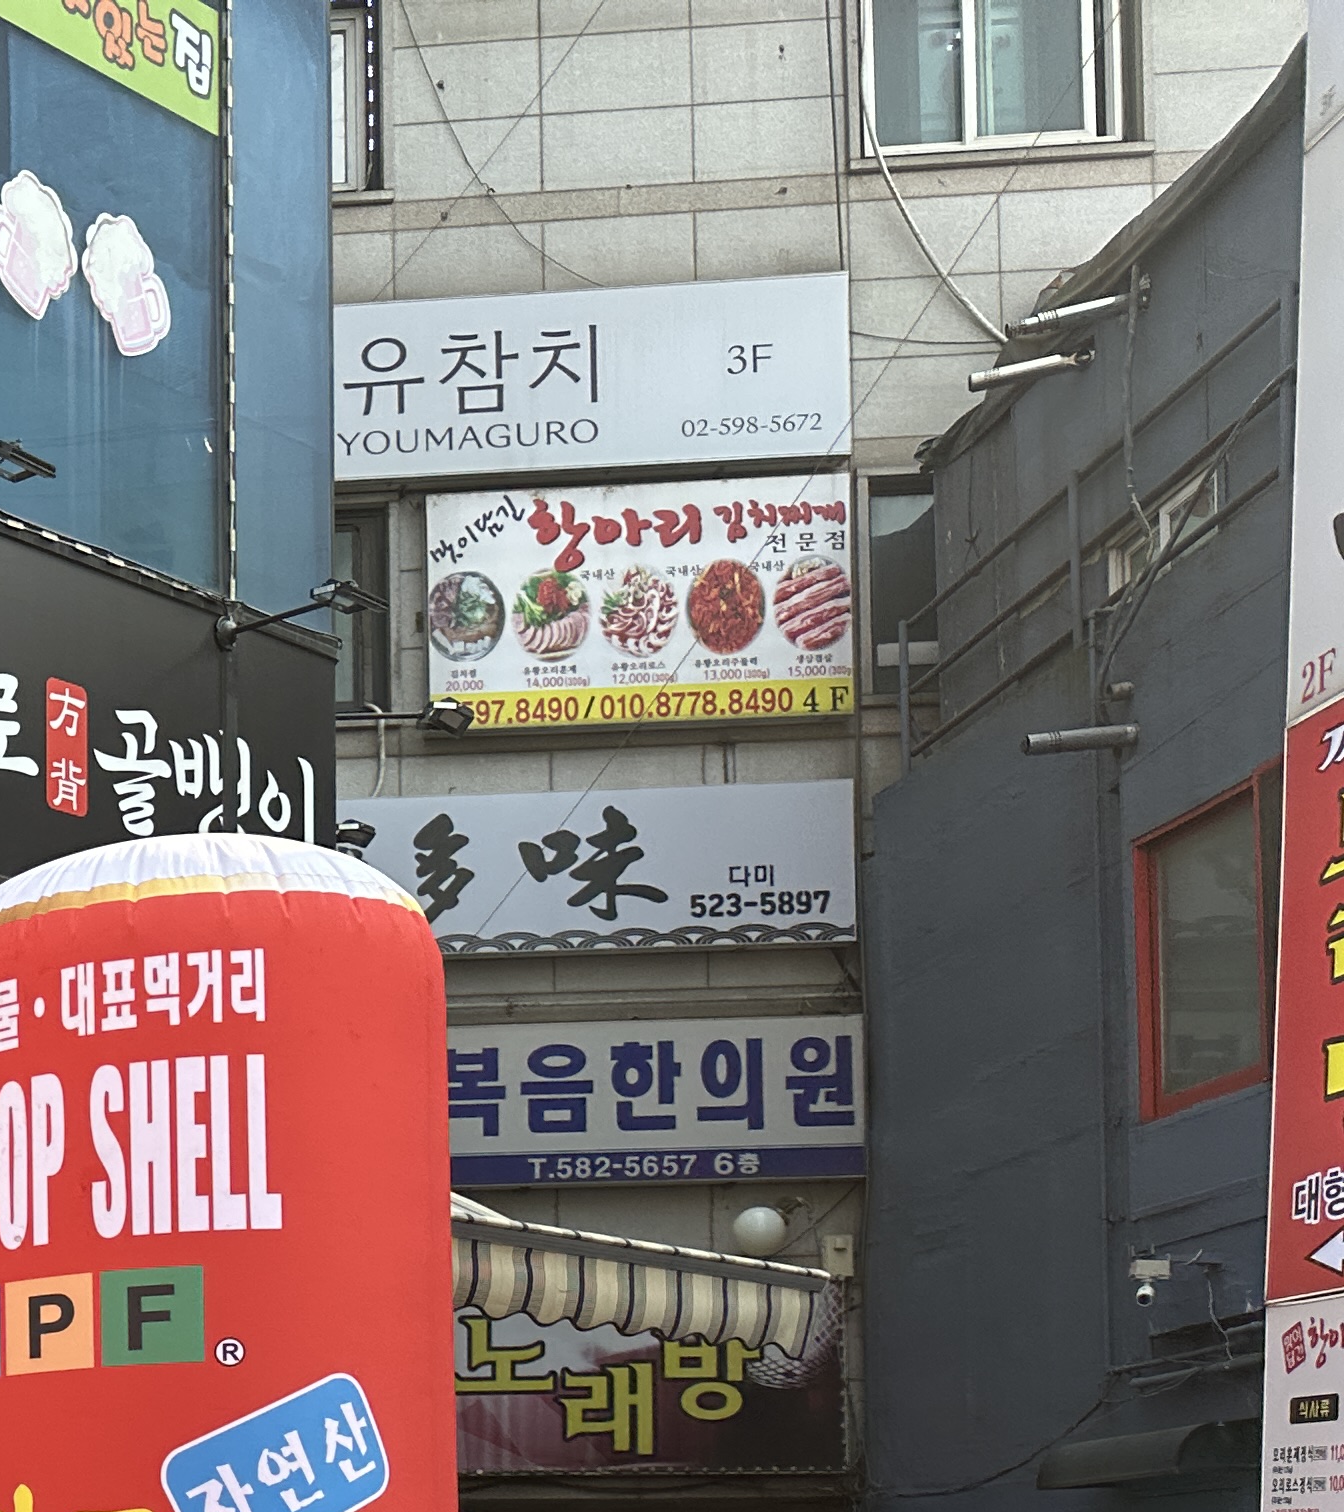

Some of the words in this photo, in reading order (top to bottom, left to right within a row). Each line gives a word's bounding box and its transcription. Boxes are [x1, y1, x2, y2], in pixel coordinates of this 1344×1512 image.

[62, 0, 168, 71] 있는
[169, 8, 214, 100] 집
[343, 324, 599, 416] 유참치
[727, 342, 774, 376] 3F
[338, 418, 599, 456] YOUMAGURO
[681, 413, 823, 438] 02-598-5672
[527, 499, 702, 573] 항아리
[713, 499, 846, 544] 김치찌개
[766, 530, 846, 553] 전문점
[580, 568, 616, 581] 국내산
[445, 680, 484, 692] 20,000
[463, 696, 579, 725] 97.8490
[600, 687, 793, 721] 010.8778.8490
[1300, 647, 1337, 704] 2F
[49, 687, 87, 812] 方背
[413, 805, 669, 923] 多味
[728, 864, 775, 888] 다미
[690, 889, 831, 918] 523-5897
[61, 948, 266, 1037] 대표먹거리
[447, 1035, 856, 1137] 복음한의원
[89, 1054, 283, 1238] SHELL
[528, 1154, 698, 1181] T.582-5657
[713, 1152, 762, 1177] 6층
[455, 1315, 761, 1457] 노래방
